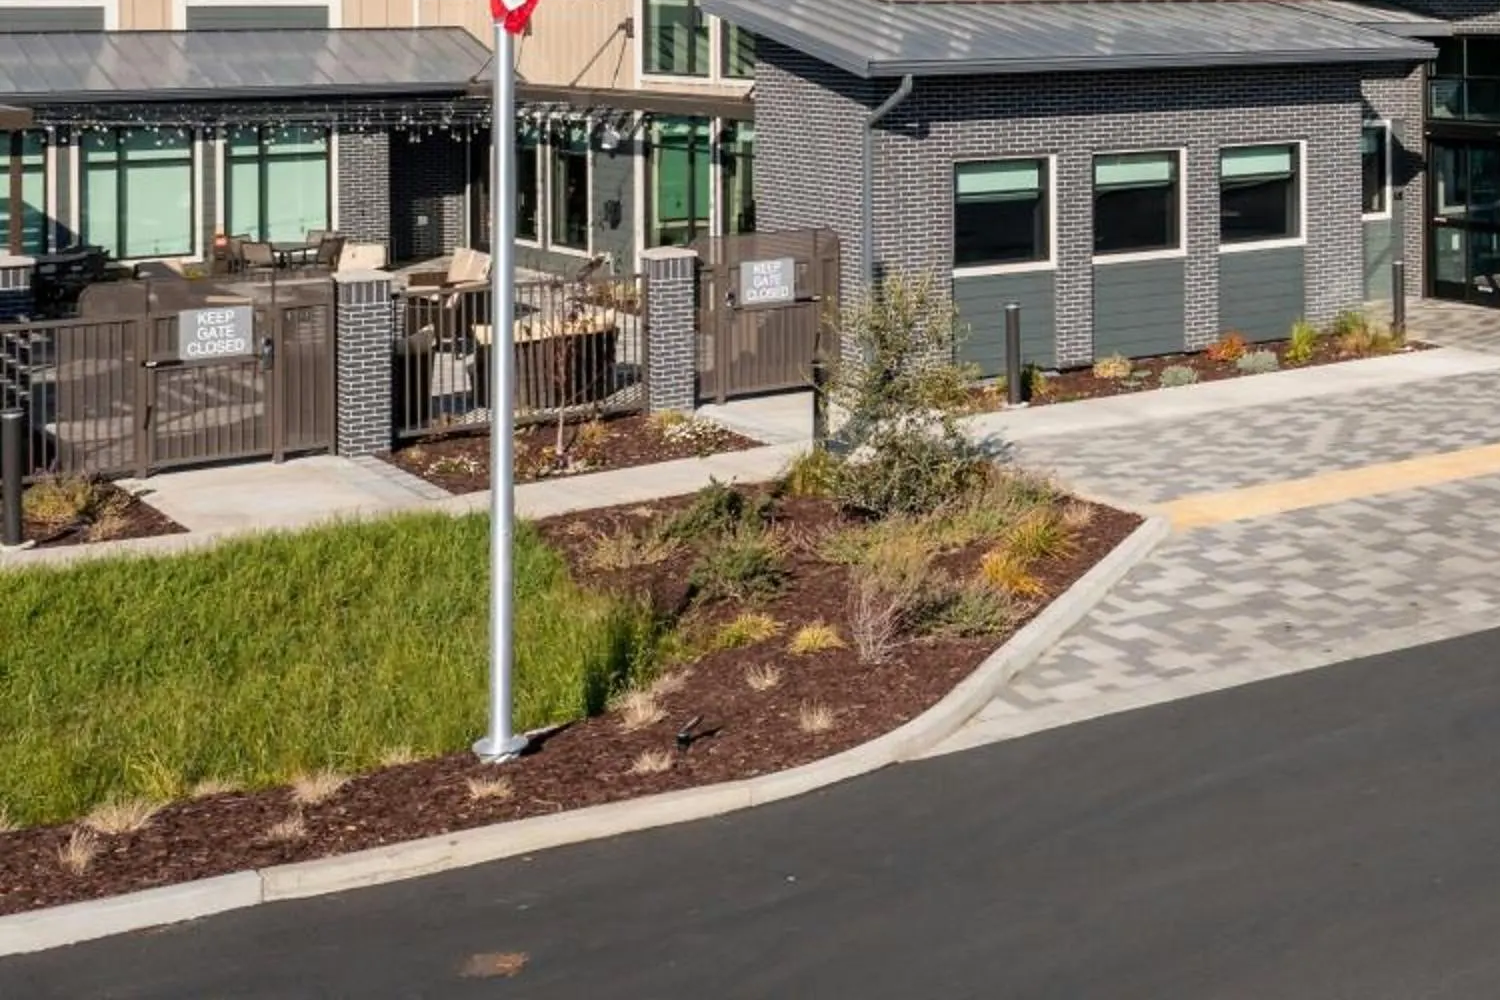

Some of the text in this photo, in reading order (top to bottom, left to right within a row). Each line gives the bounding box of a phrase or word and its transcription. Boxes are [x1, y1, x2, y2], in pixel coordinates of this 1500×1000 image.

[197, 310, 235, 325] KEEP
[197, 325, 236, 340] GATE
[187, 338, 245, 356] CLOSED
